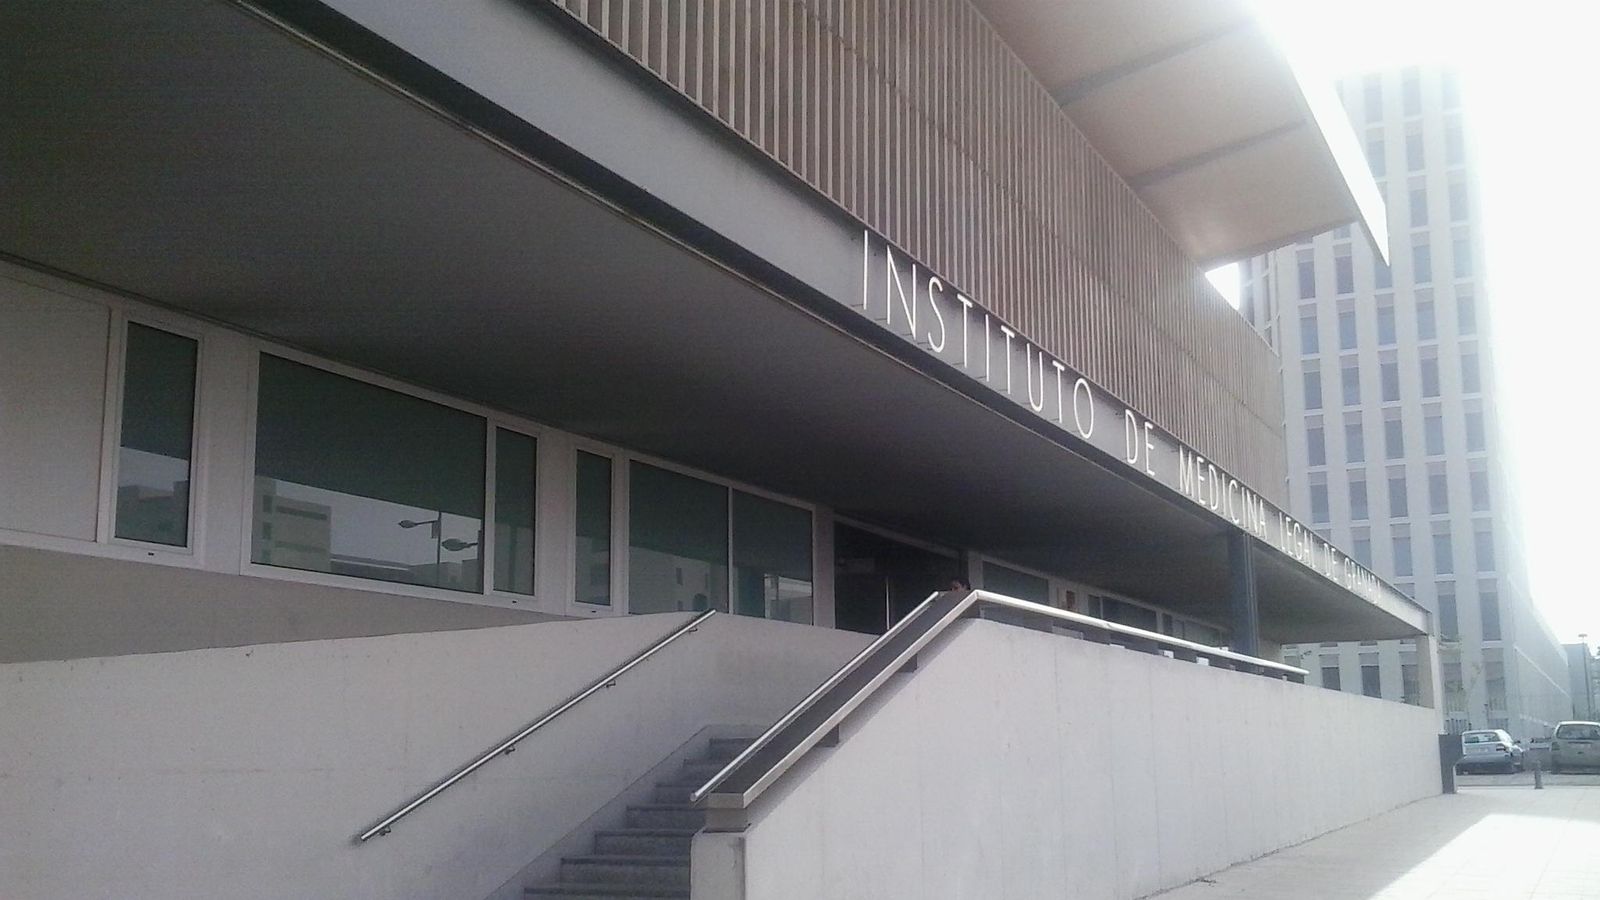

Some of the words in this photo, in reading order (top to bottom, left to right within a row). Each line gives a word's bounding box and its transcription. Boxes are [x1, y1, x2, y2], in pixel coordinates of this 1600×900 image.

[864, 229, 1094, 438] INSTITUTO
[1125, 409, 1155, 475] DE
[1179, 444, 1267, 541] MEDICINA
[1279, 511, 1317, 568] LEGAL
[1323, 543, 1337, 581] DE
